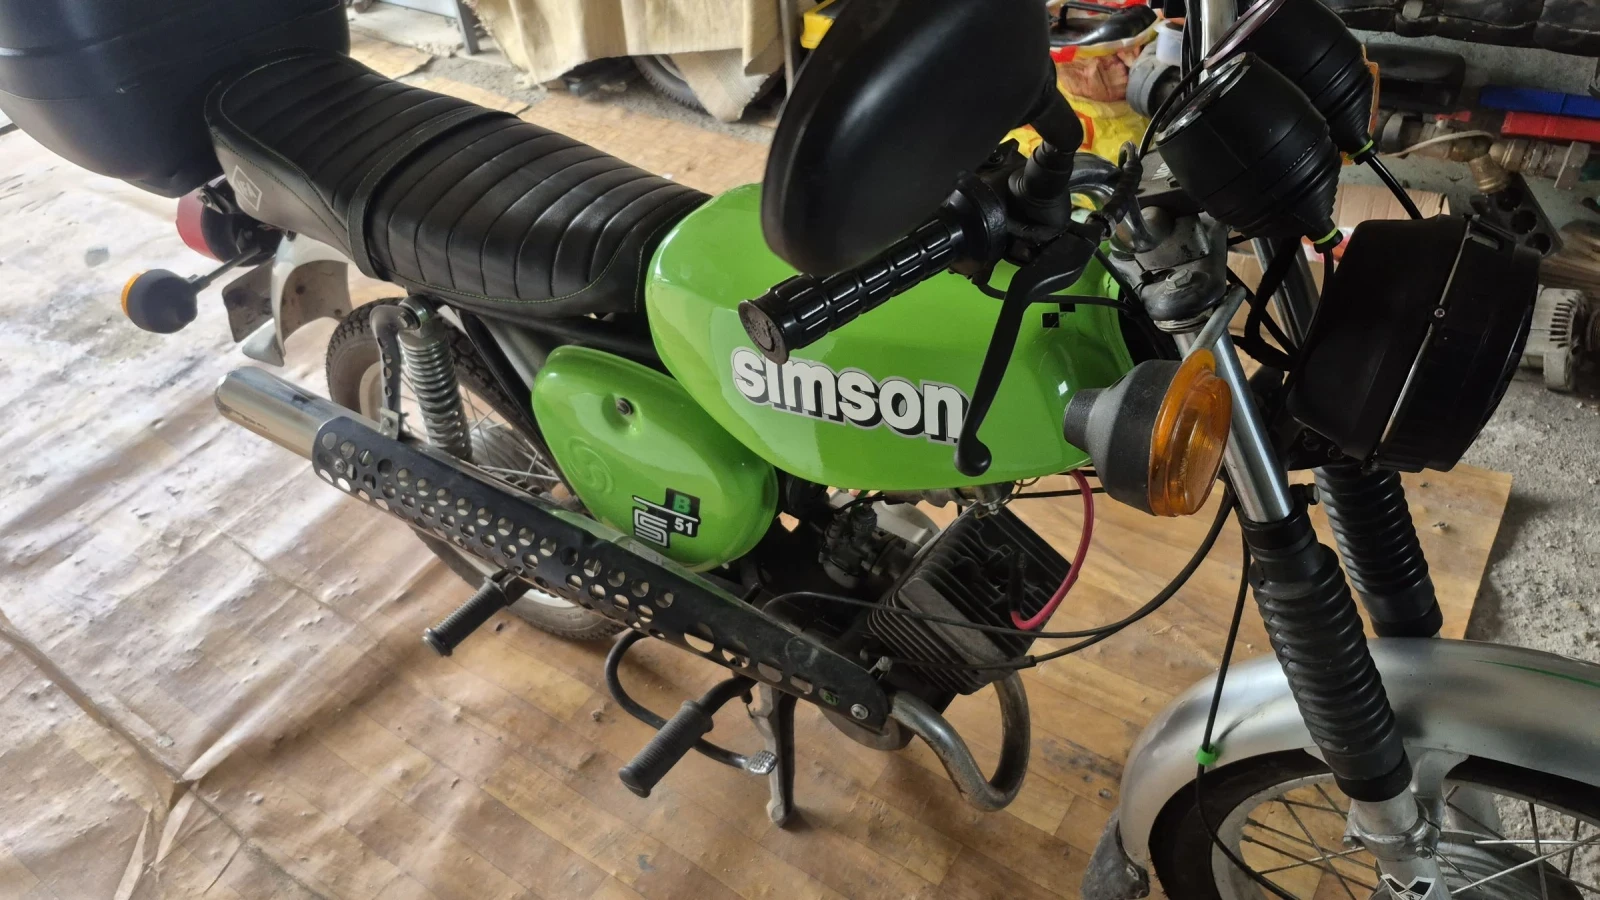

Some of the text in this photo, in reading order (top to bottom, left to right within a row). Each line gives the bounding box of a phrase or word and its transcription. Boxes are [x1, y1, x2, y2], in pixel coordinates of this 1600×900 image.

[732, 349, 967, 441] simson
[672, 493, 691, 515] B
[674, 517, 693, 535] 51
